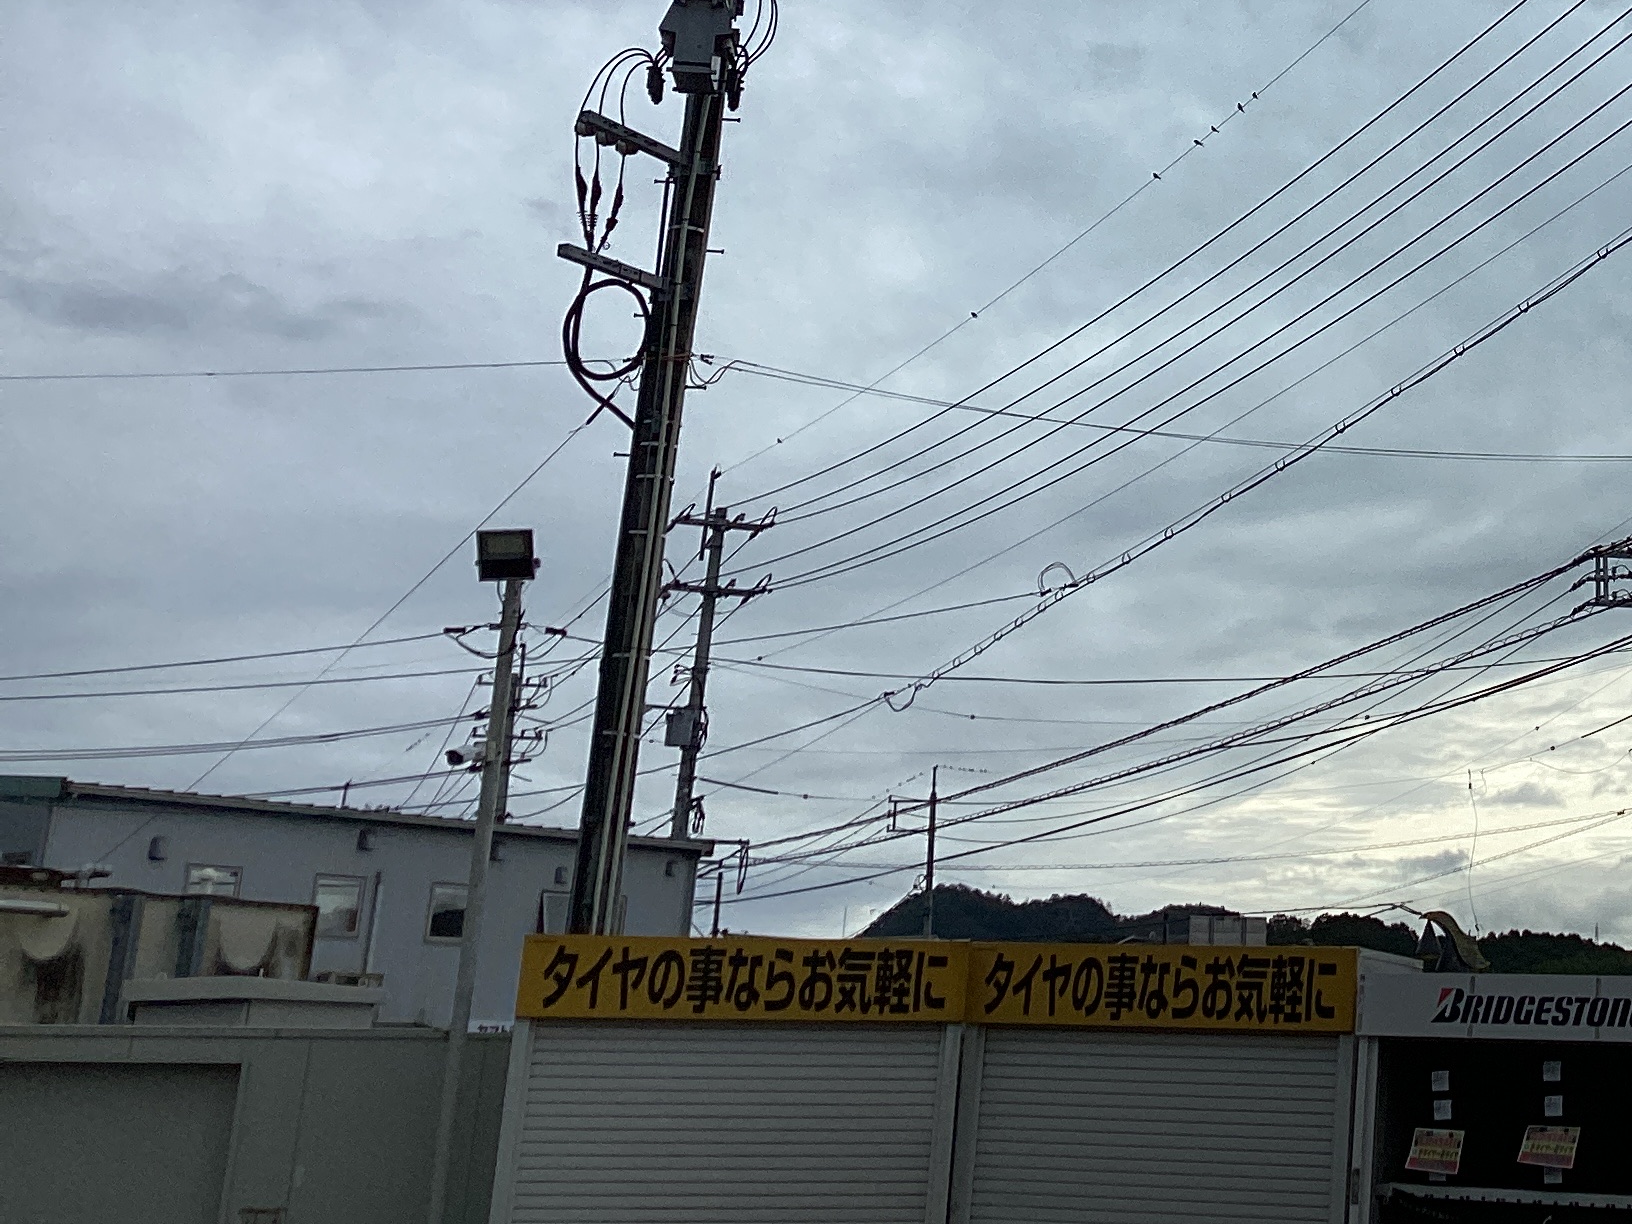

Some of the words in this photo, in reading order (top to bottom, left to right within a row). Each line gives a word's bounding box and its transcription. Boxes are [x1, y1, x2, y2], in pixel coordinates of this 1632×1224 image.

[542, 945, 947, 1016] タイヤの事ならお気軽に
[984, 952, 1337, 1024] タイヤの事ならお気軽に
